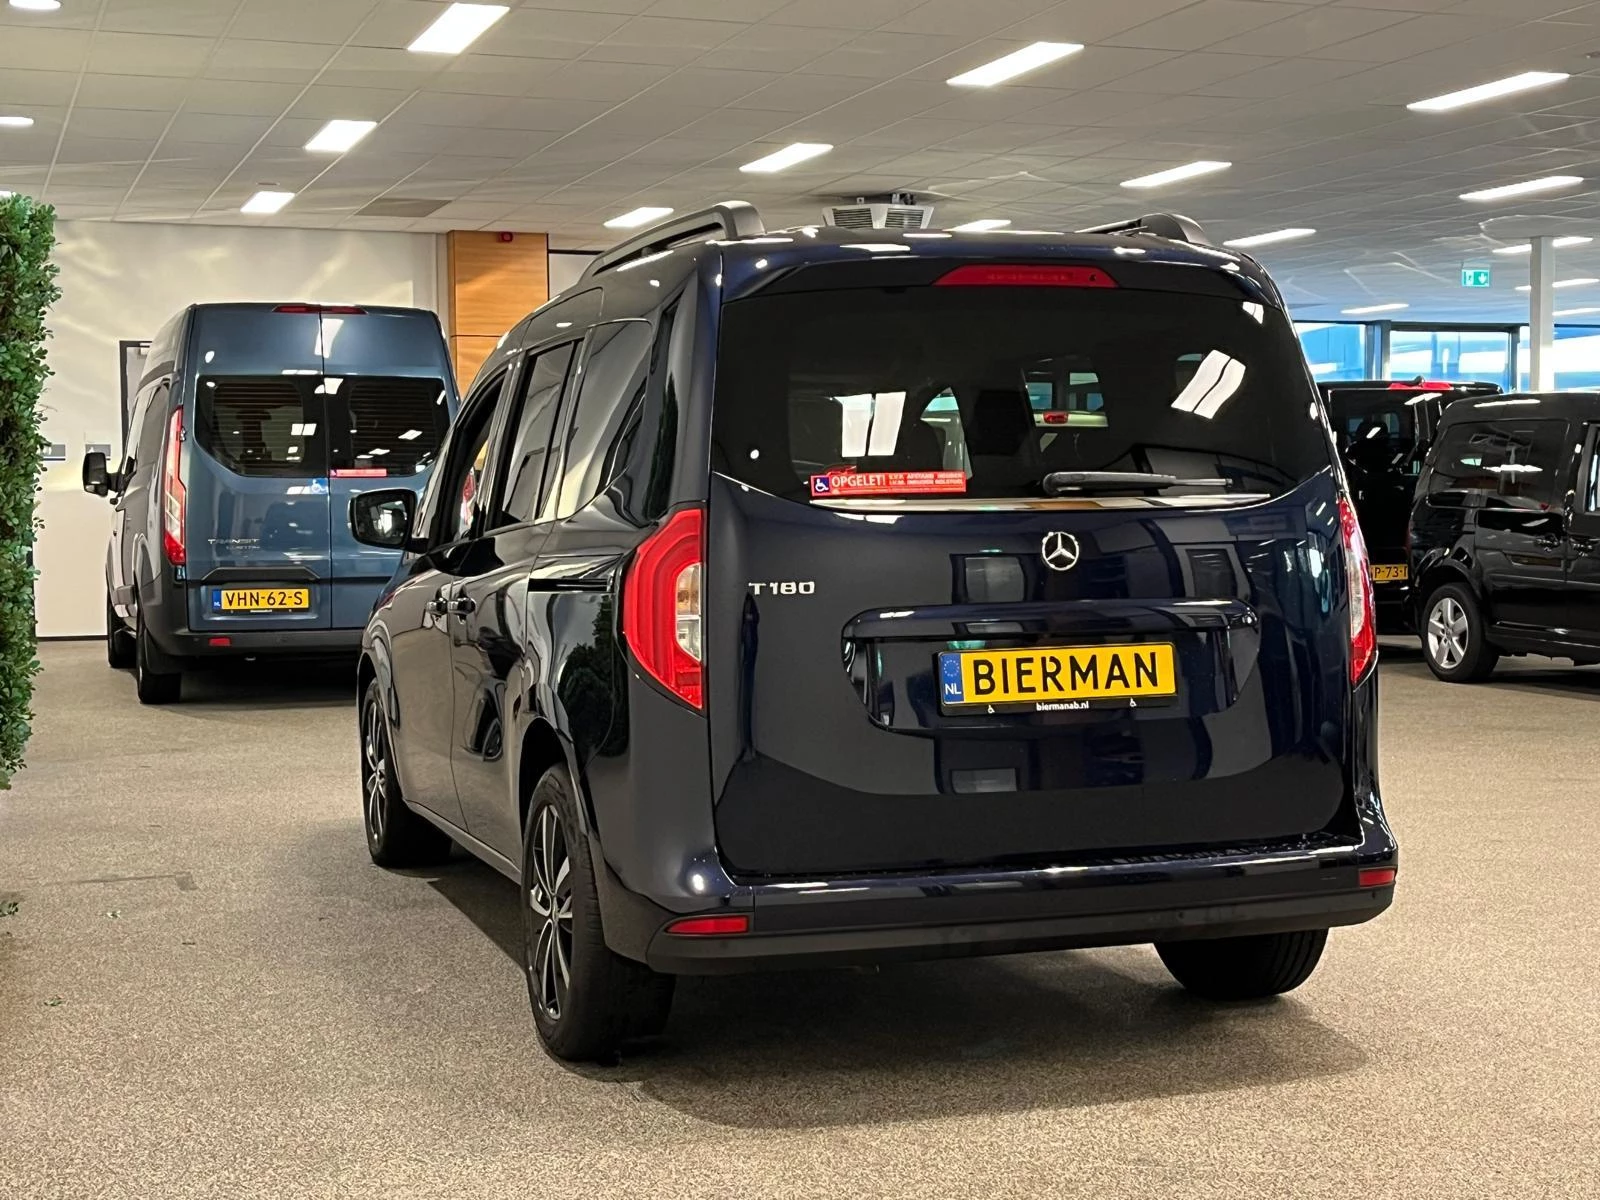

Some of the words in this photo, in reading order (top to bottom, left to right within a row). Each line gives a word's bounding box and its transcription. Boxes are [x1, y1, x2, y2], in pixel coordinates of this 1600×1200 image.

[831, 474, 886, 487] OPGELET!
[226, 591, 303, 606] VHN-62-S
[945, 683, 962, 695] NL
[972, 651, 1159, 696] BIERMAN
[1036, 700, 1090, 711] biermanab.nl
